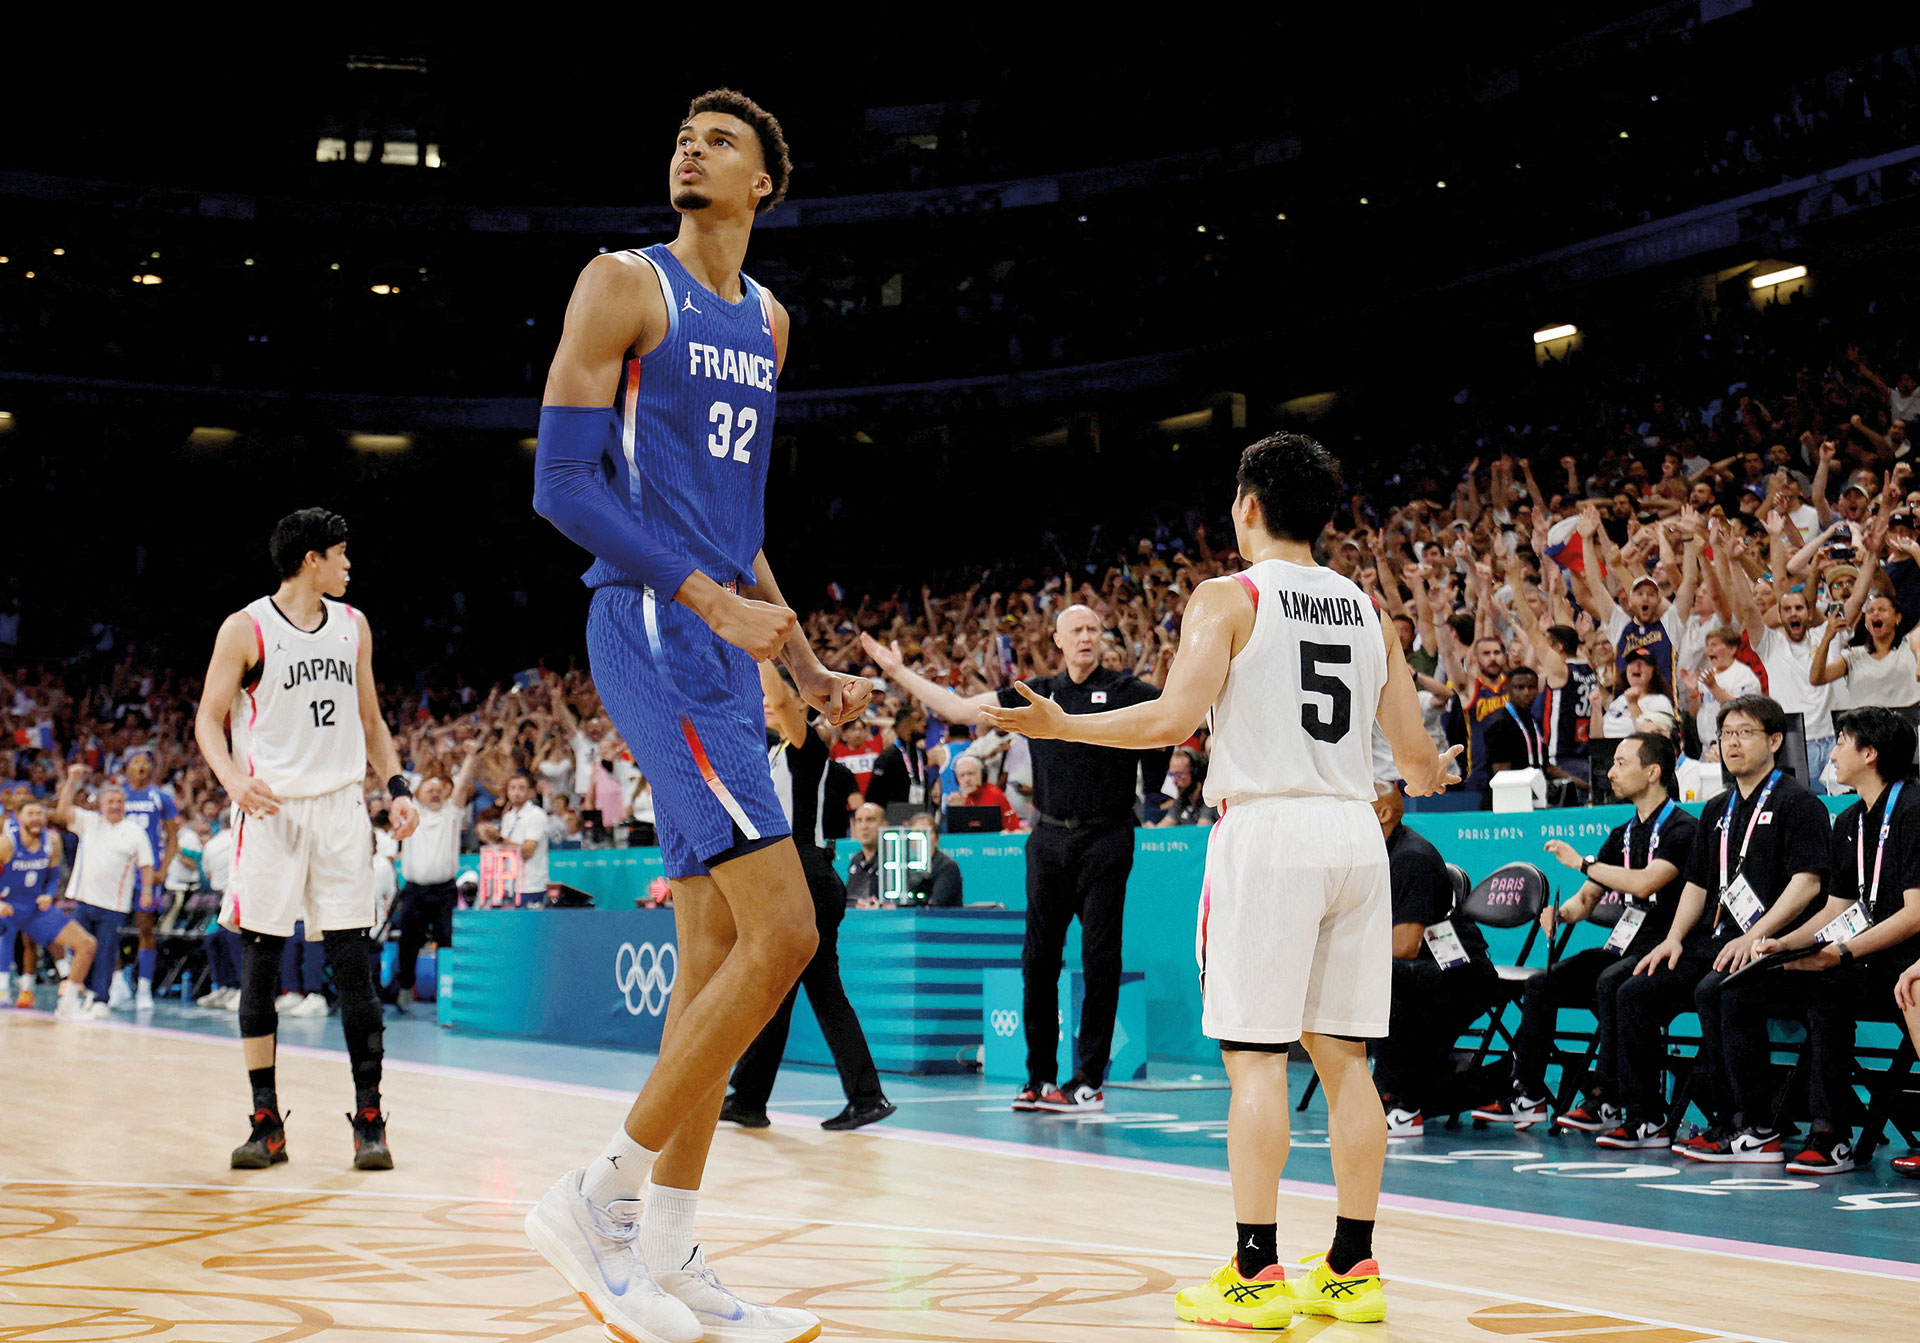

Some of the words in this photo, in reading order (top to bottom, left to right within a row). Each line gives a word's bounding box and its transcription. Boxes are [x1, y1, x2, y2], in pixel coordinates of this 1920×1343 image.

[688, 341, 775, 393] FRANCE
[708, 401, 758, 464] 32
[1278, 590, 1365, 628] KAWAMURA
[283, 658, 353, 690] JAPAN
[1299, 640, 1352, 744] 5
[309, 699, 335, 728] 12
[1458, 828, 1490, 840] PARIS
[1493, 827, 1523, 839] 2024
[1541, 825, 1575, 837] PARIS
[1578, 824, 1611, 837] 2024
[1490, 877, 1525, 891] PARIS
[1600, 891, 1622, 905] 20
[1487, 892, 1521, 906] 2024
